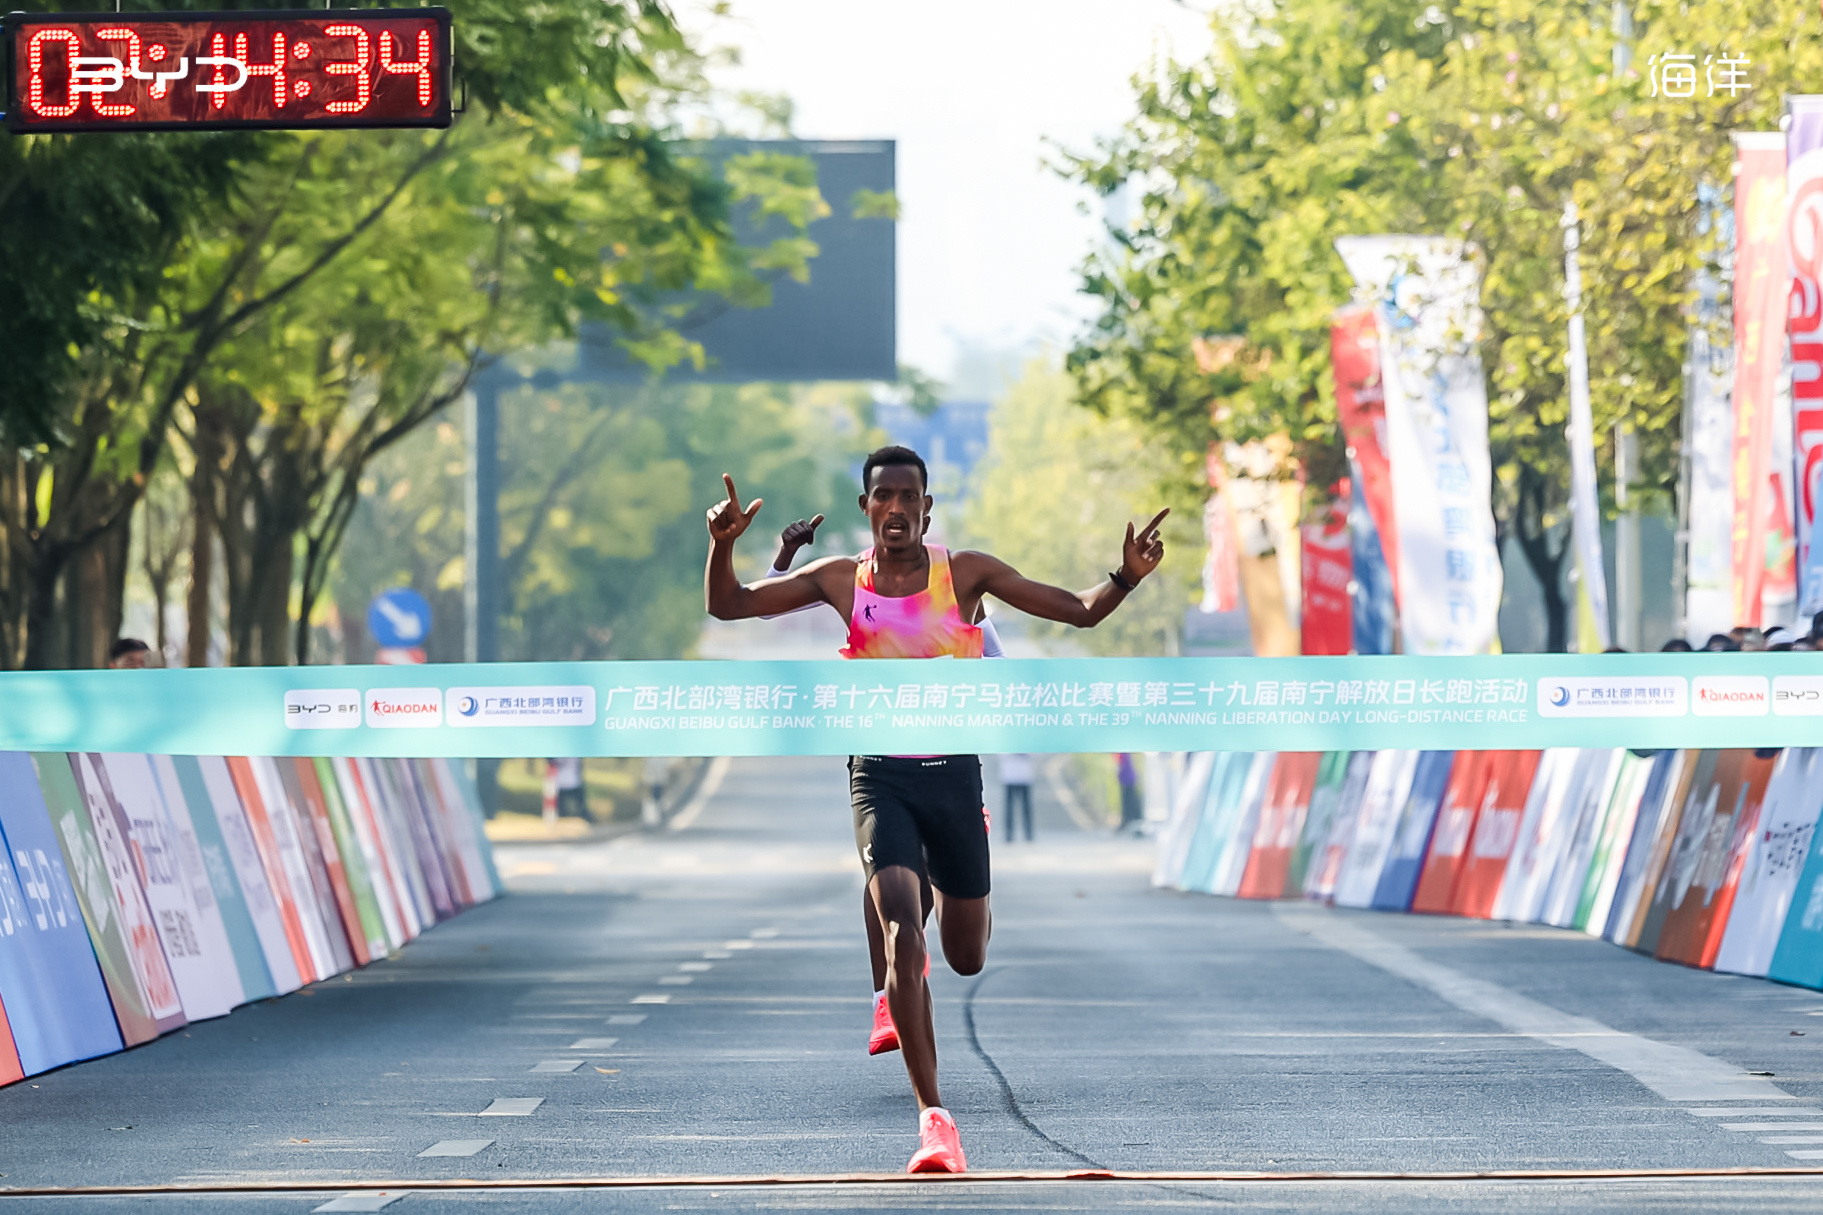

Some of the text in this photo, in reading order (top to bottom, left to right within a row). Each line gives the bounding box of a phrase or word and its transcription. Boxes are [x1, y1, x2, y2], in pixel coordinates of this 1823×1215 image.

[1709, 692, 1765, 702] QIAODAN
[1775, 691, 1820, 700] BYD
[484, 696, 584, 708] 广西北部湾银行
[287, 704, 332, 714] BYD
[382, 704, 438, 714] QIAODAN
[604, 717, 675, 730] GUANGXI
[679, 717, 724, 729] BEIBU
[728, 717, 769, 729] GULF
[772, 716, 816, 728] BANK
[824, 716, 854, 728] THE
[892, 714, 964, 728] NANNING
[967, 714, 1059, 727] MARATHON
[1062, 713, 1074, 726] &
[1078, 713, 1108, 726] THE
[1145, 712, 1217, 725] NANNING
[1222, 712, 1315, 725] LIBERATION
[1319, 711, 1352, 724] DAY
[1355, 711, 1483, 724] LONG-DISTANCE
[1487, 710, 1528, 723] RACE
